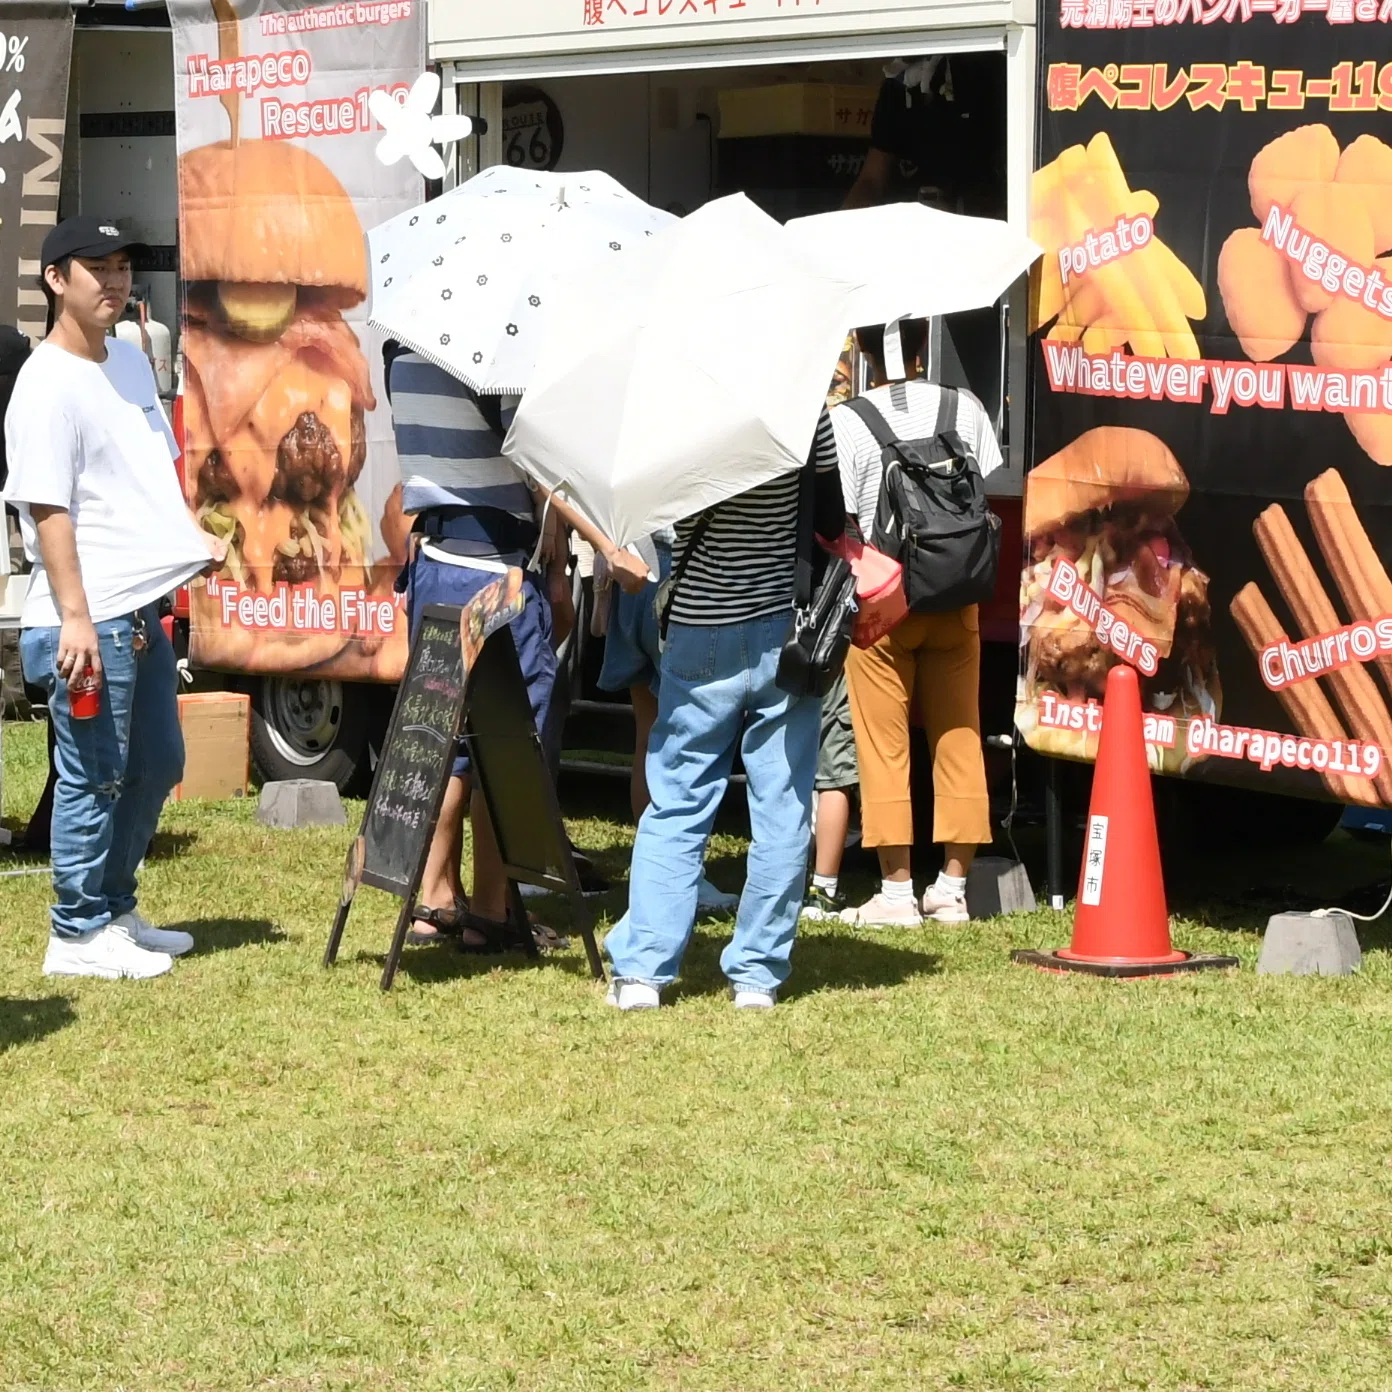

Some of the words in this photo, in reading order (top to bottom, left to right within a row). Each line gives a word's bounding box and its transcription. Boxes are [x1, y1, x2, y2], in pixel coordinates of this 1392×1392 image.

[261, 14, 285, 35] The
[287, 4, 354, 32] authentic
[356, 0, 411, 25] burgers
[188, 54, 309, 94] Harapeco
[507, 128, 548, 167] 66
[1059, 215, 1153, 283] Potato
[1048, 344, 1206, 398] Whatever
[1212, 366, 1282, 411] you
[292, 588, 336, 630] the
[1049, 559, 1159, 673] Burgers
[1041, 695, 1175, 744] Instam
[1187, 720, 1380, 777] @harapeco119
[1087, 821, 1105, 894] 宝塚市
